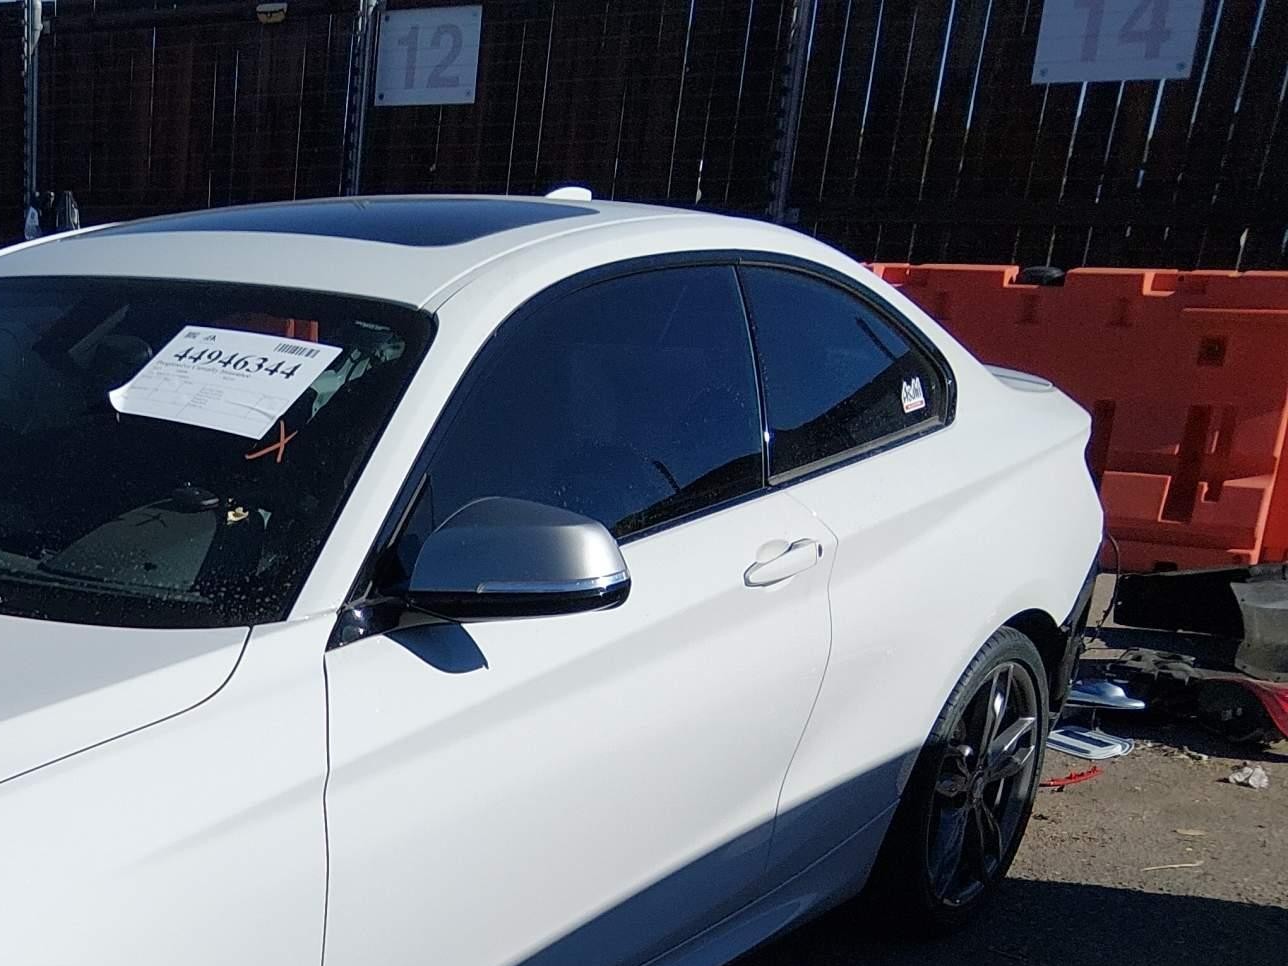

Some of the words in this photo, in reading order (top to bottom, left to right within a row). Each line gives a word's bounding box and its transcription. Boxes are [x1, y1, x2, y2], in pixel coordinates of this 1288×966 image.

[397, 24, 462, 89] 12
[1072, 0, 1172, 62] 14
[173, 346, 303, 380] 44946344
